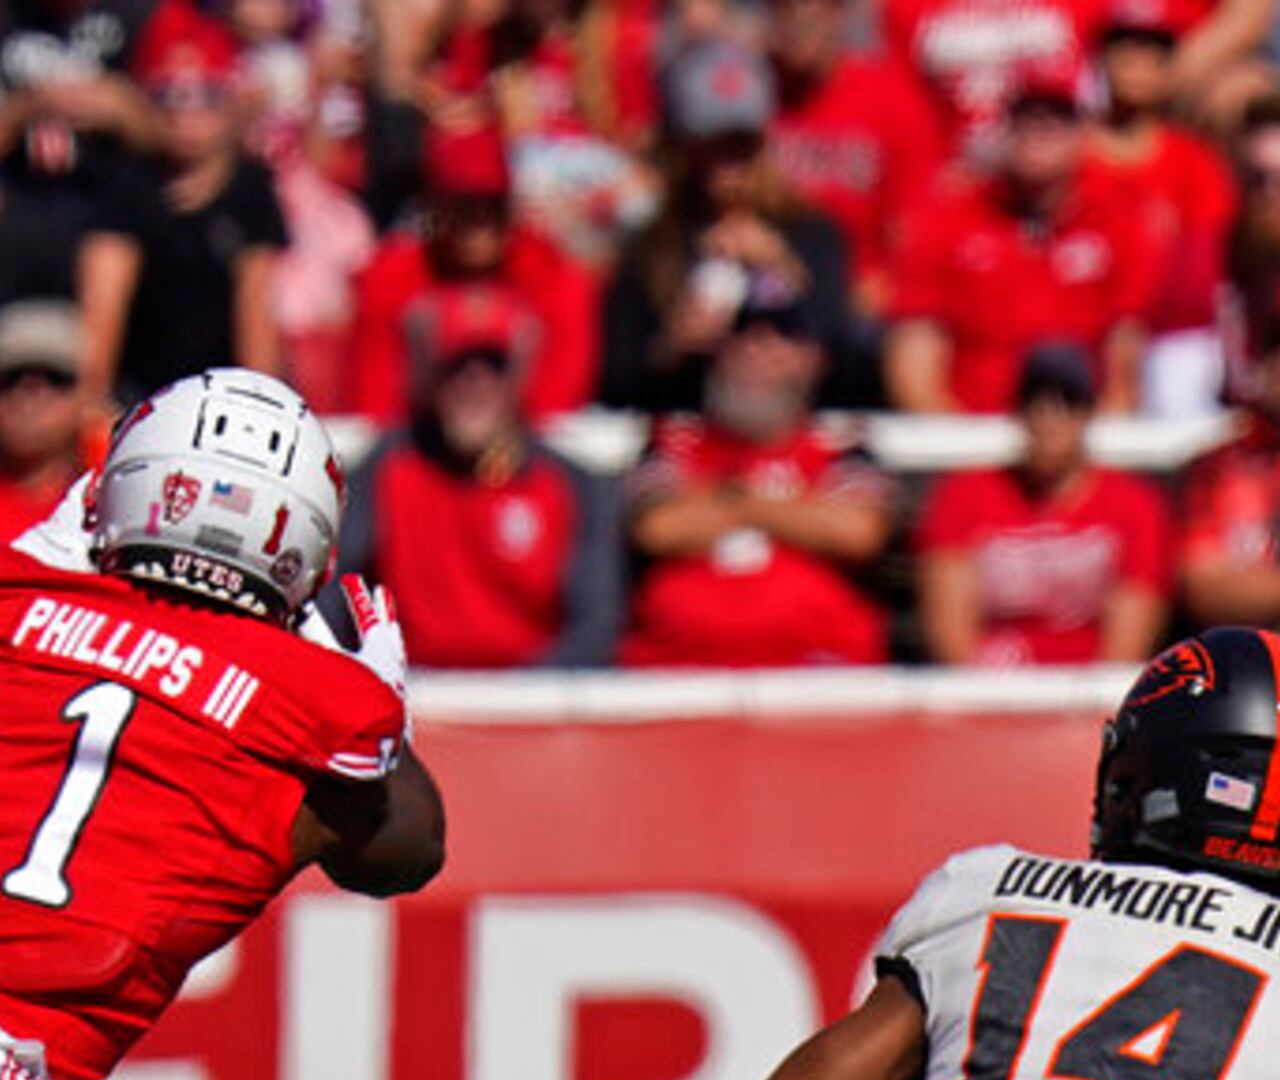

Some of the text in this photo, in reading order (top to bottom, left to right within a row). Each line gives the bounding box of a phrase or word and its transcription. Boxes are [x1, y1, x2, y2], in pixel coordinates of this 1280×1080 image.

[171, 552, 245, 592] UTES
[11, 596, 260, 729] PHILLIPS III
[1, 679, 137, 908] 1
[994, 855, 1233, 934] DUNMORE
